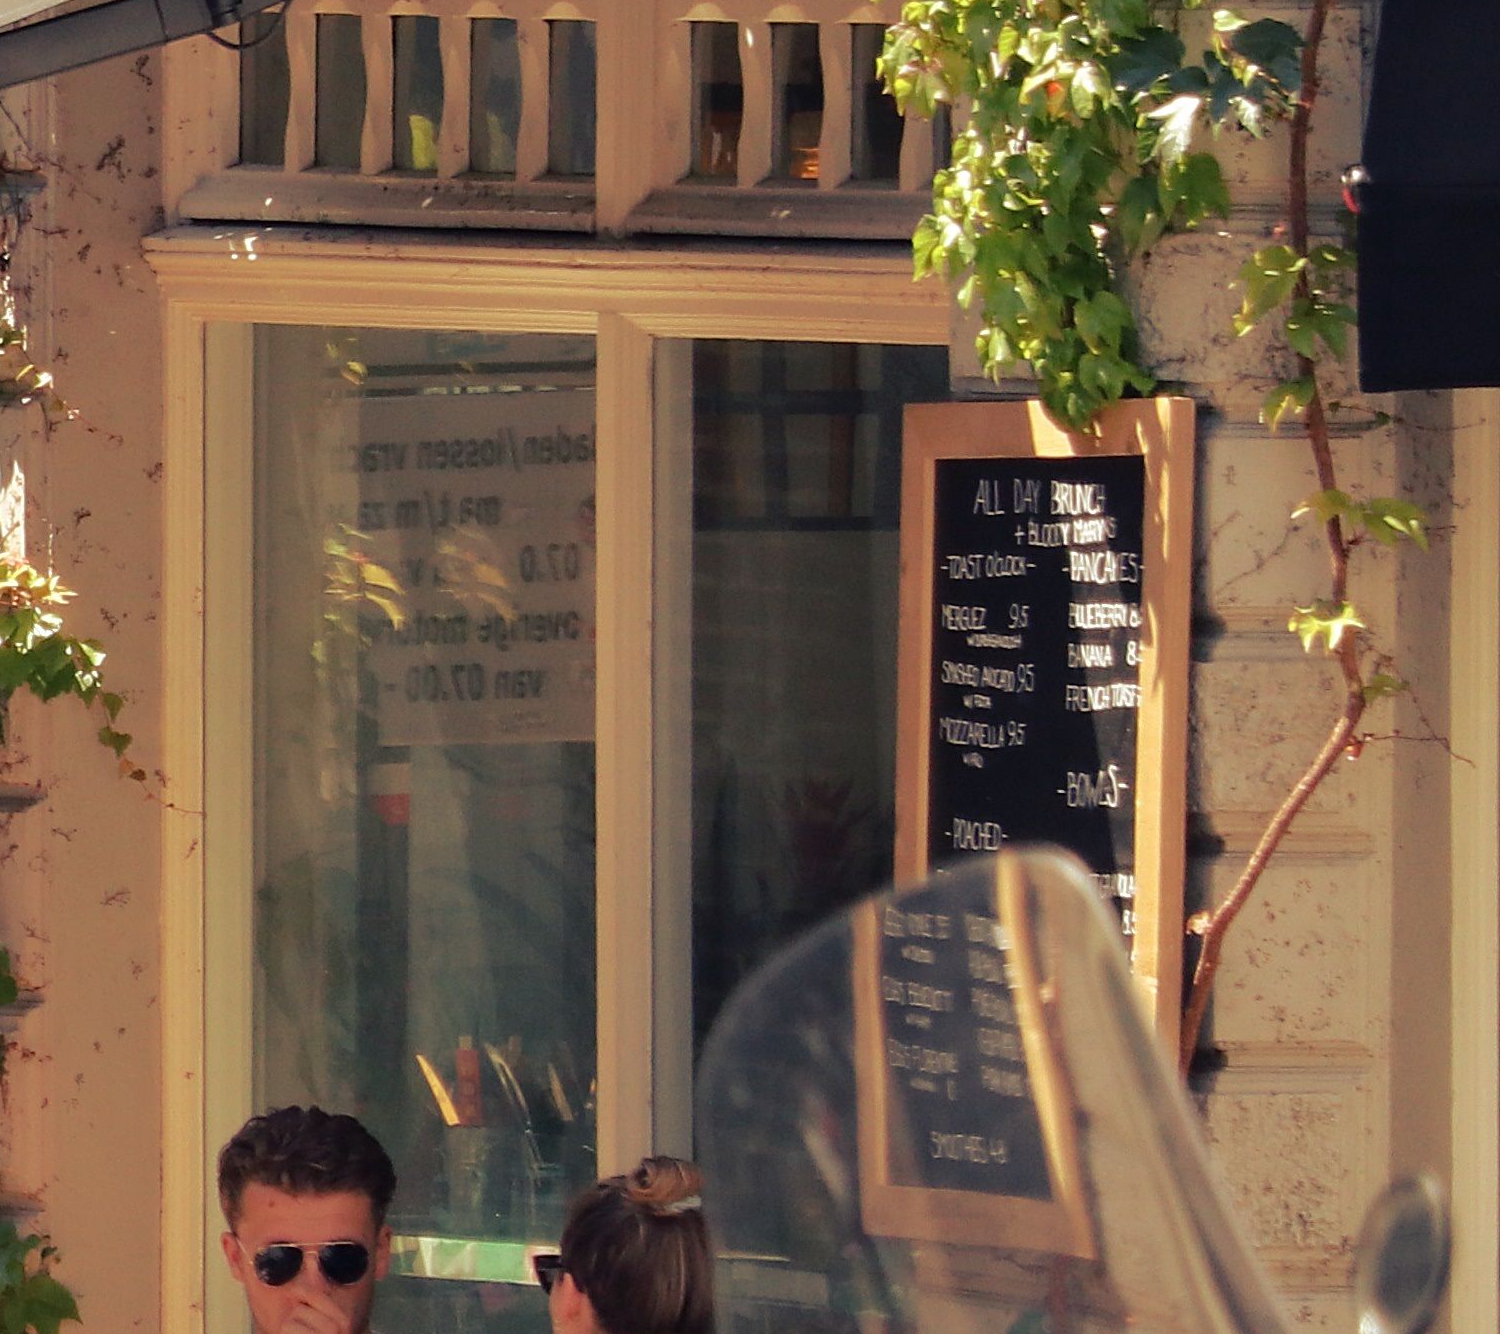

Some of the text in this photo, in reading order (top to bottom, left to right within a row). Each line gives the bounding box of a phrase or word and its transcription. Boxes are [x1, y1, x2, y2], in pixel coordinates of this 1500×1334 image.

[972, 477, 1106, 516] ALL DAY BRUNCH
[1067, 642, 1114, 668] BANANA
